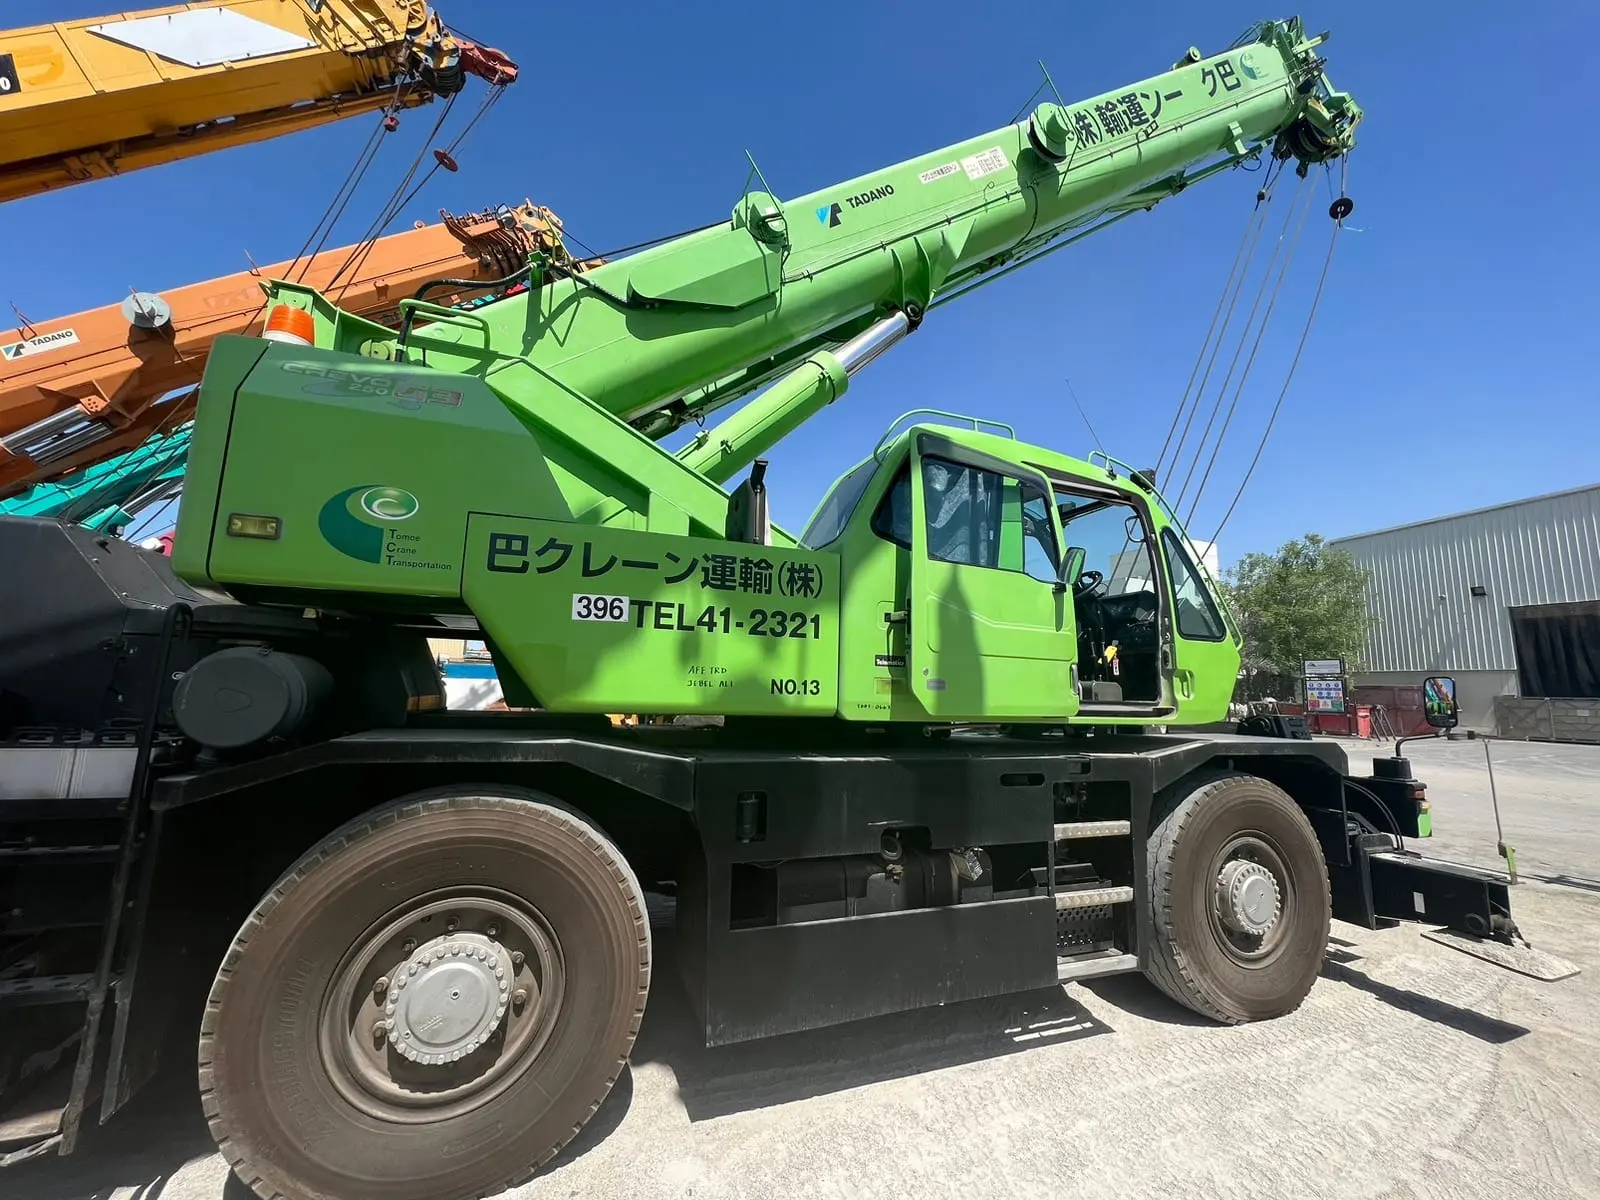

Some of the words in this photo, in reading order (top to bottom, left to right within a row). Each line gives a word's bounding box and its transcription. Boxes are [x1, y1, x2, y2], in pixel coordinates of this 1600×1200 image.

[845, 184, 895, 209] TADANO
[30, 330, 73, 347] TADANO
[348, 383, 388, 396] 250
[388, 528, 421, 541] Tomoe
[386, 541, 417, 554] Crane
[385, 554, 452, 570] Transportation
[486, 532, 824, 599] 巴クレーン運輸(株)
[576, 595, 625, 621] 396
[770, 678, 821, 696] NO.13
